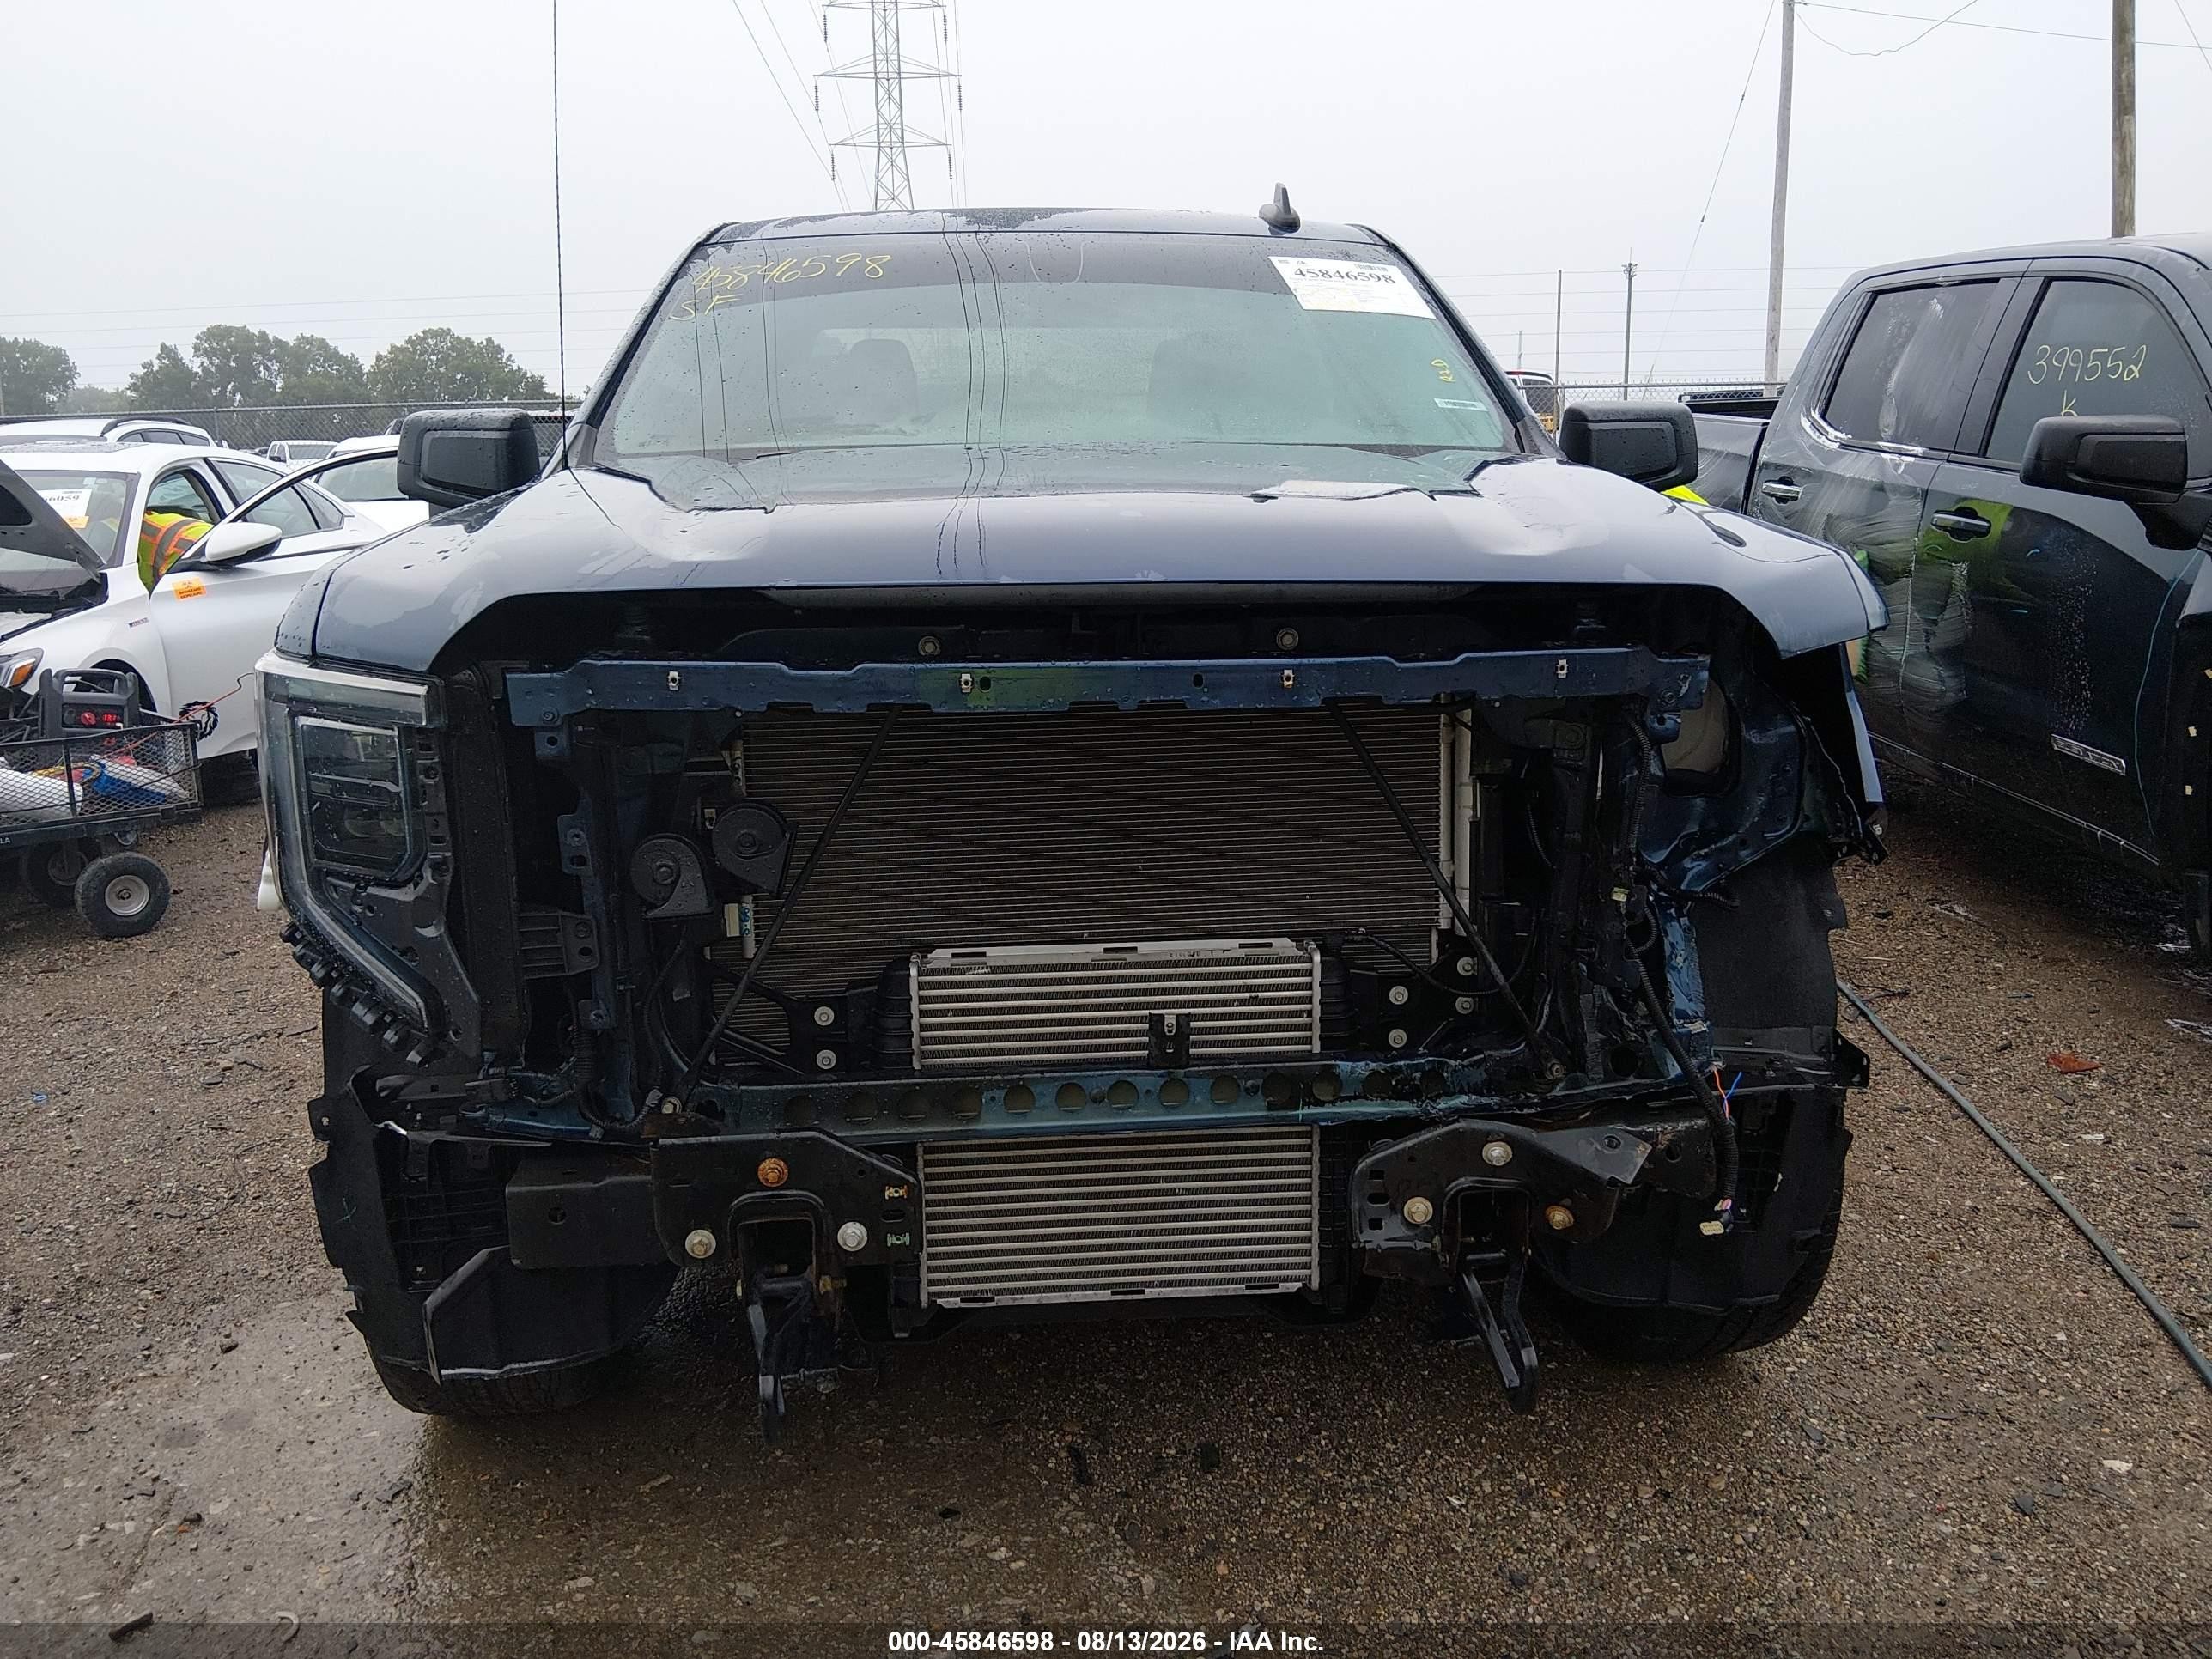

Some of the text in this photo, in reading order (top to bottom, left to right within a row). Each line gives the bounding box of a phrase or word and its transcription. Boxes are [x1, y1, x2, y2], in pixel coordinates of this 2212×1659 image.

[692, 252, 892, 293] 45846598
[1294, 267, 1395, 284] 45846598
[2027, 344, 2147, 385] 399552
